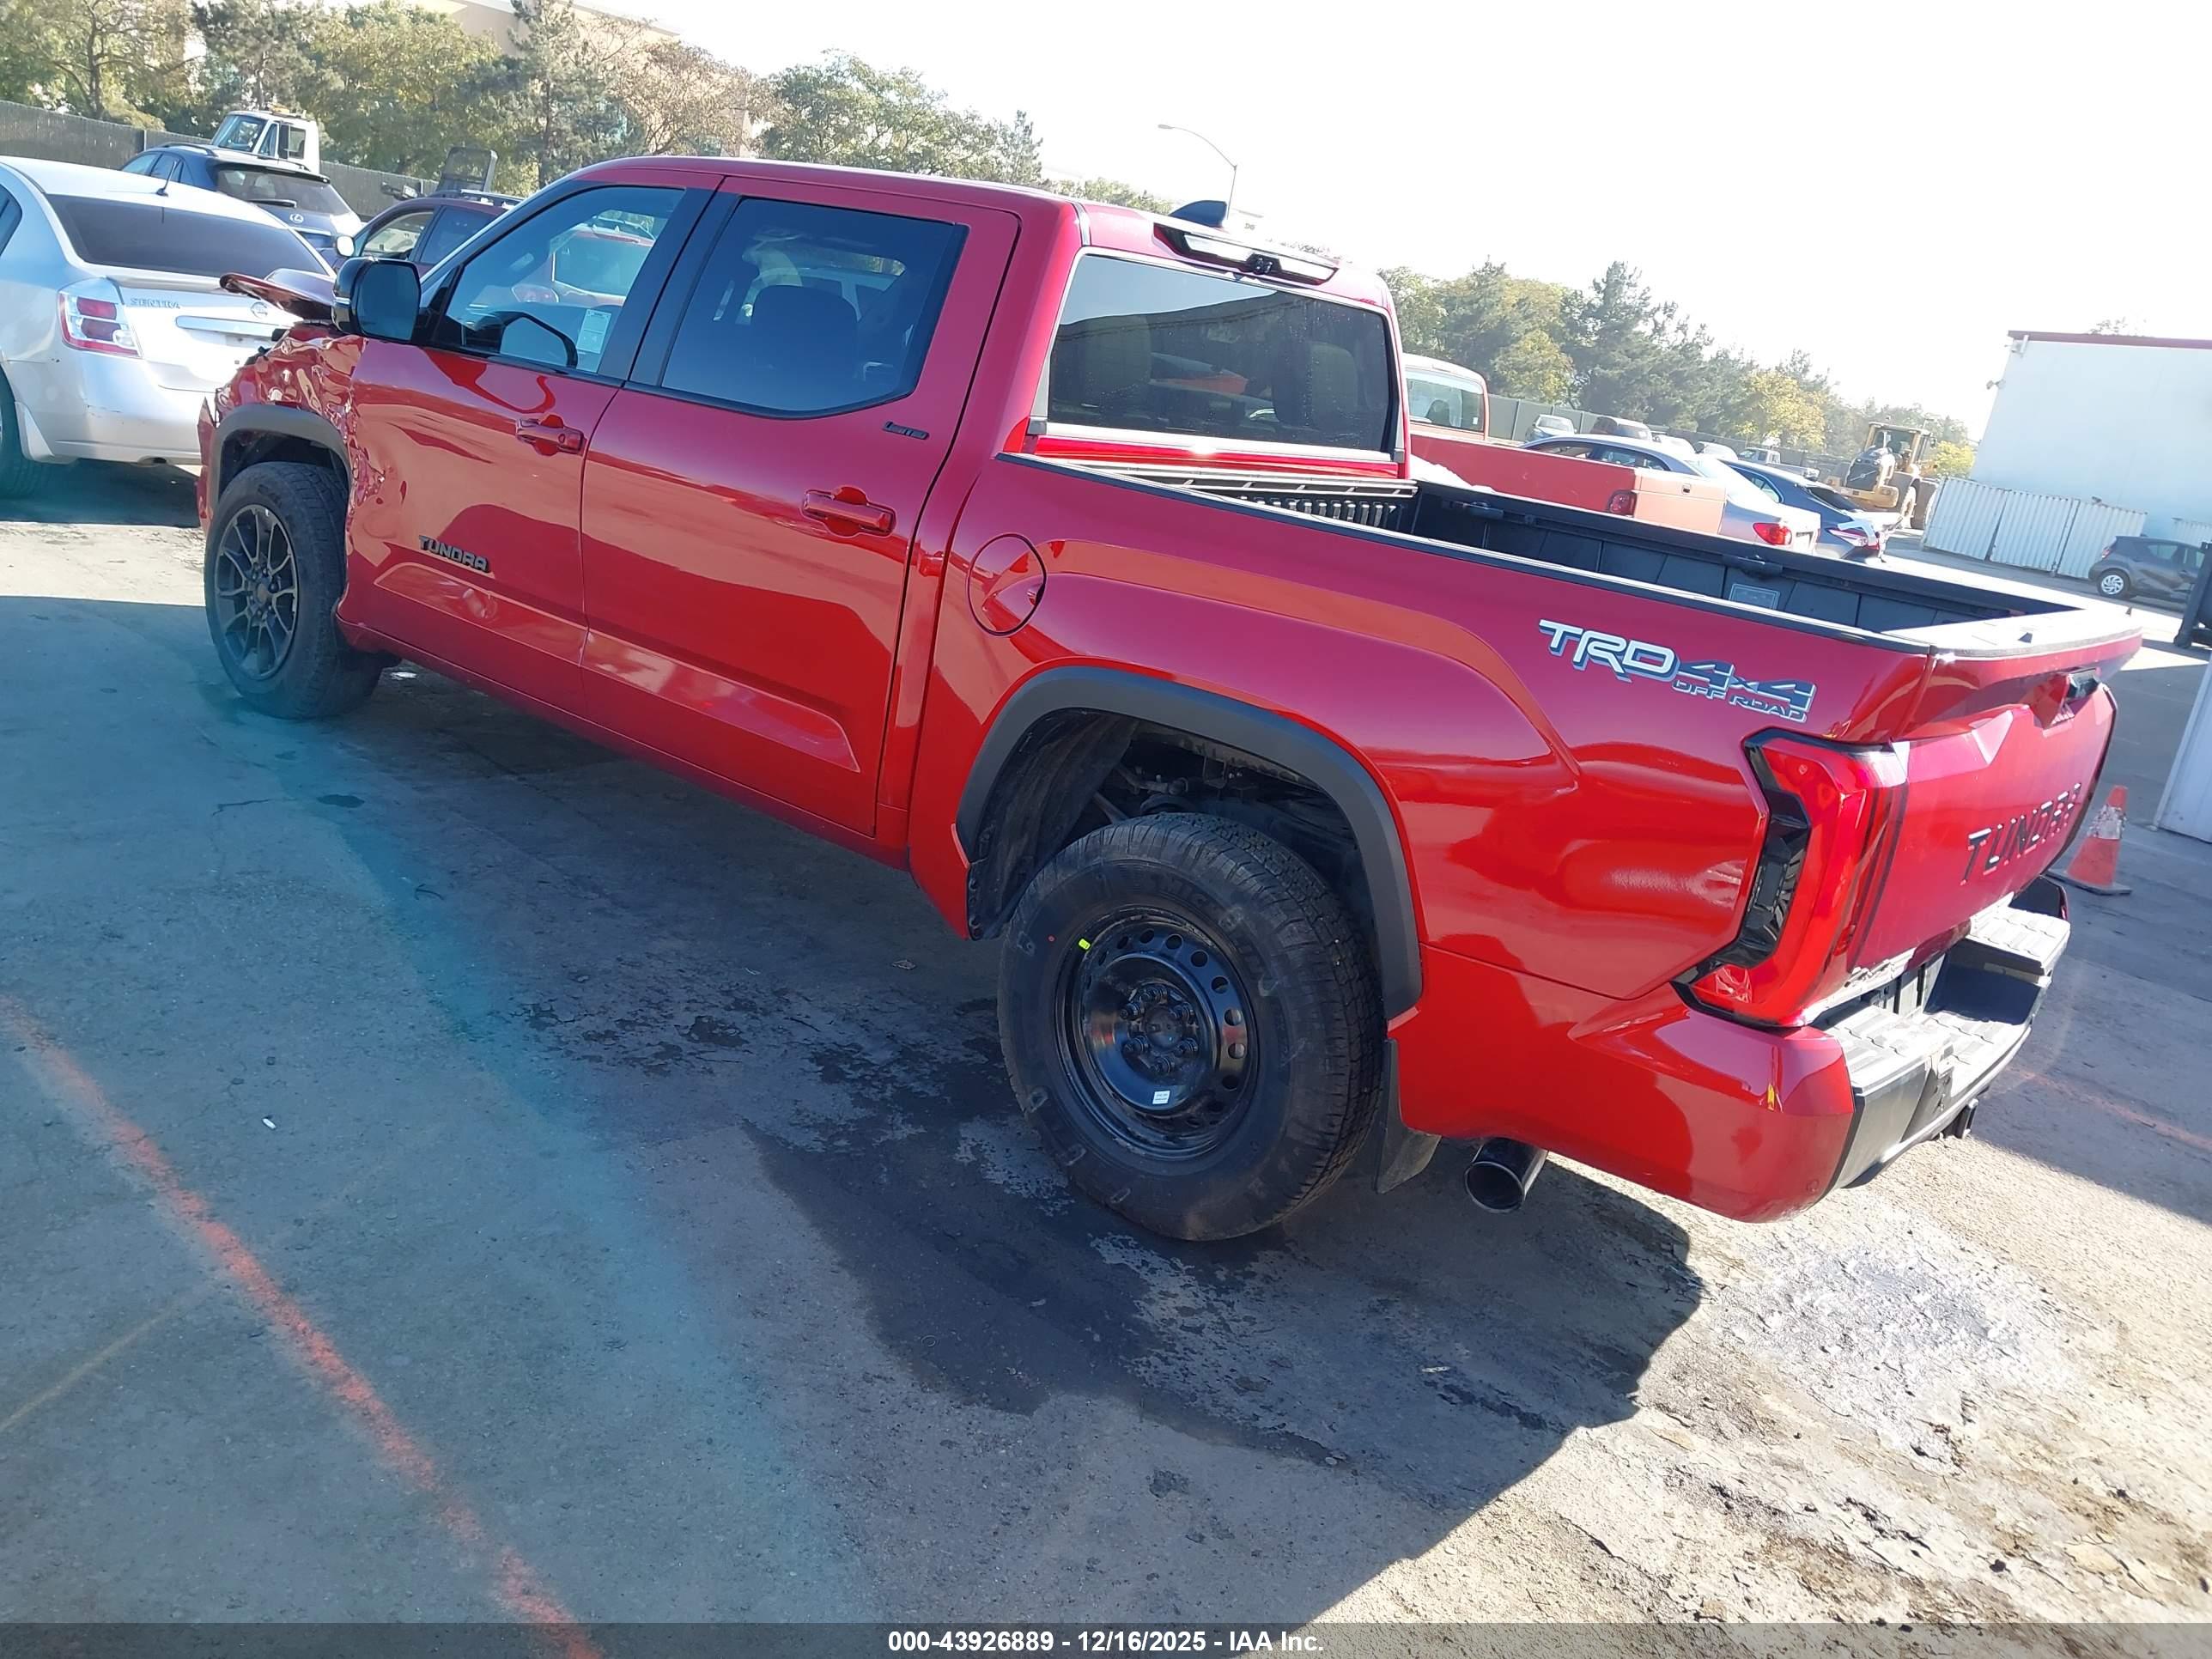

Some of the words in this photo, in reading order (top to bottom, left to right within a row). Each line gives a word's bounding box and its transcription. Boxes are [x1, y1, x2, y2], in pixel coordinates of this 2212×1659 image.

[130, 297, 181, 309] SENTRA
[418, 534, 489, 573] TUNDRA
[1539, 618, 1680, 683] TRD
[1671, 678, 1727, 702] OFF
[1728, 694, 1808, 723] ROAD
